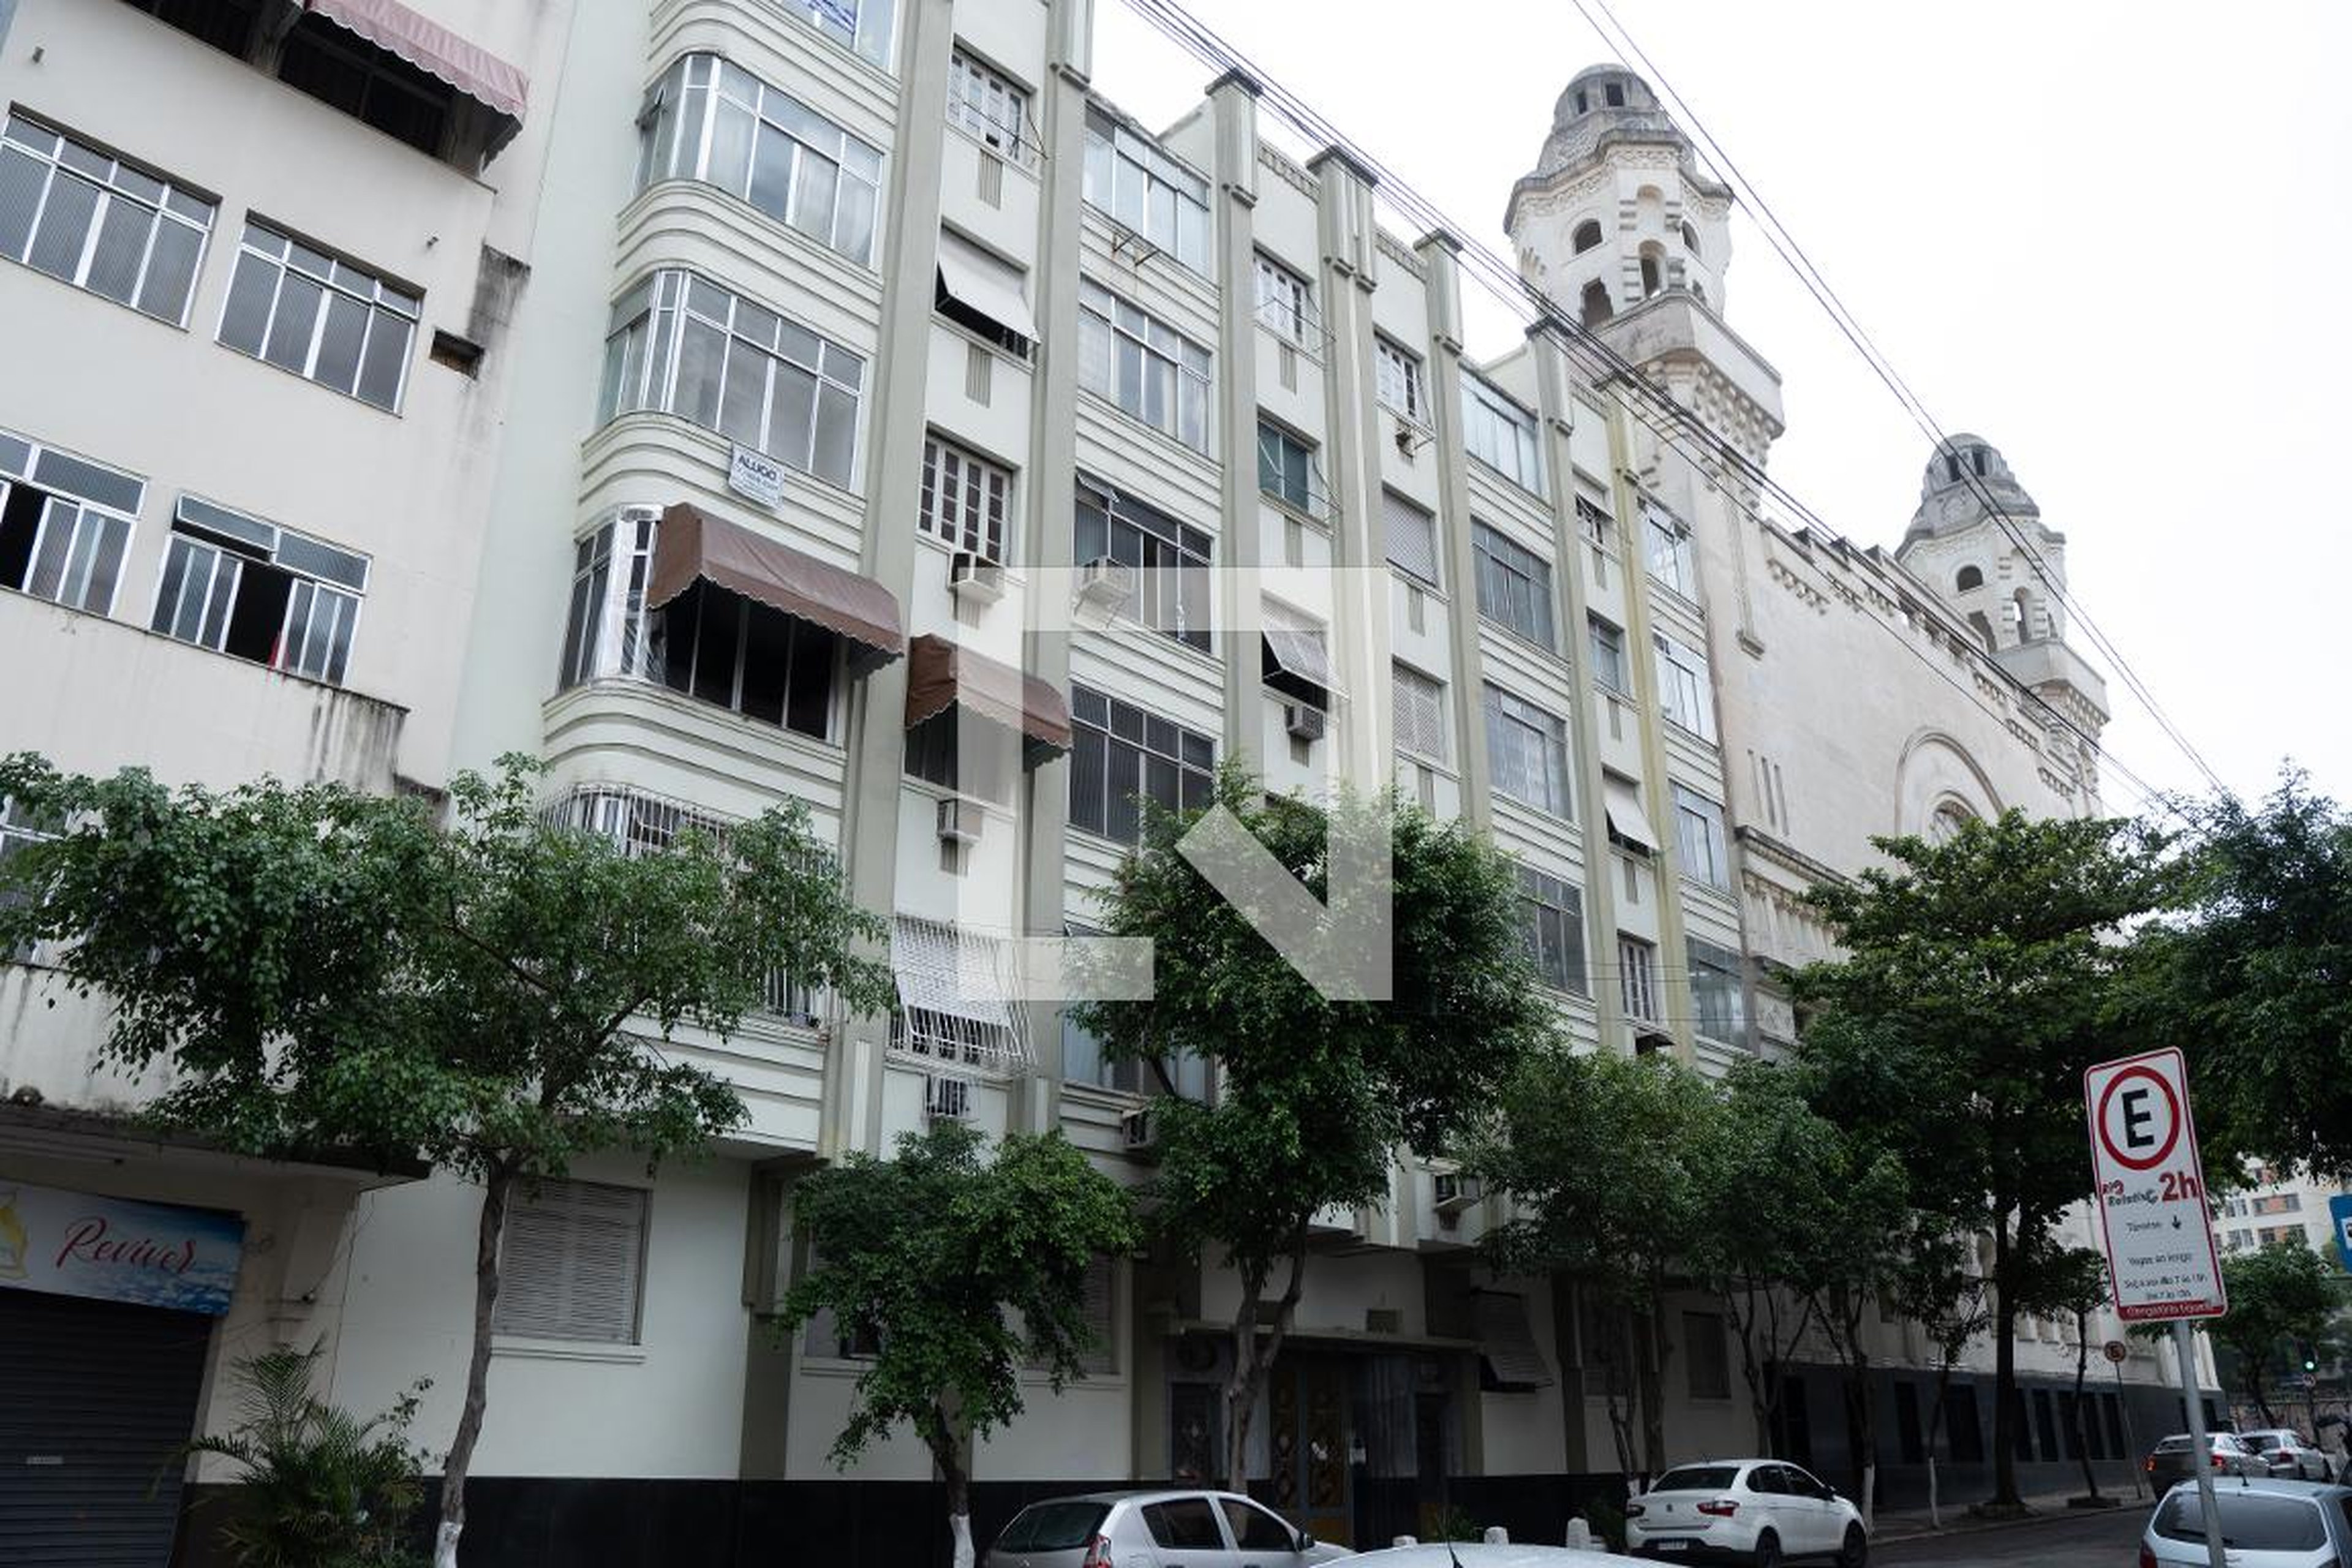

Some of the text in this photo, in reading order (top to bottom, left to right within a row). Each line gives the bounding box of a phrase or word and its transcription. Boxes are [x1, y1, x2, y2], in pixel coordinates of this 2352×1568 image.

[737, 454, 777, 481] ALUGO
[2122, 1088, 2154, 1148] E
[2158, 1171, 2198, 1202] 2h
